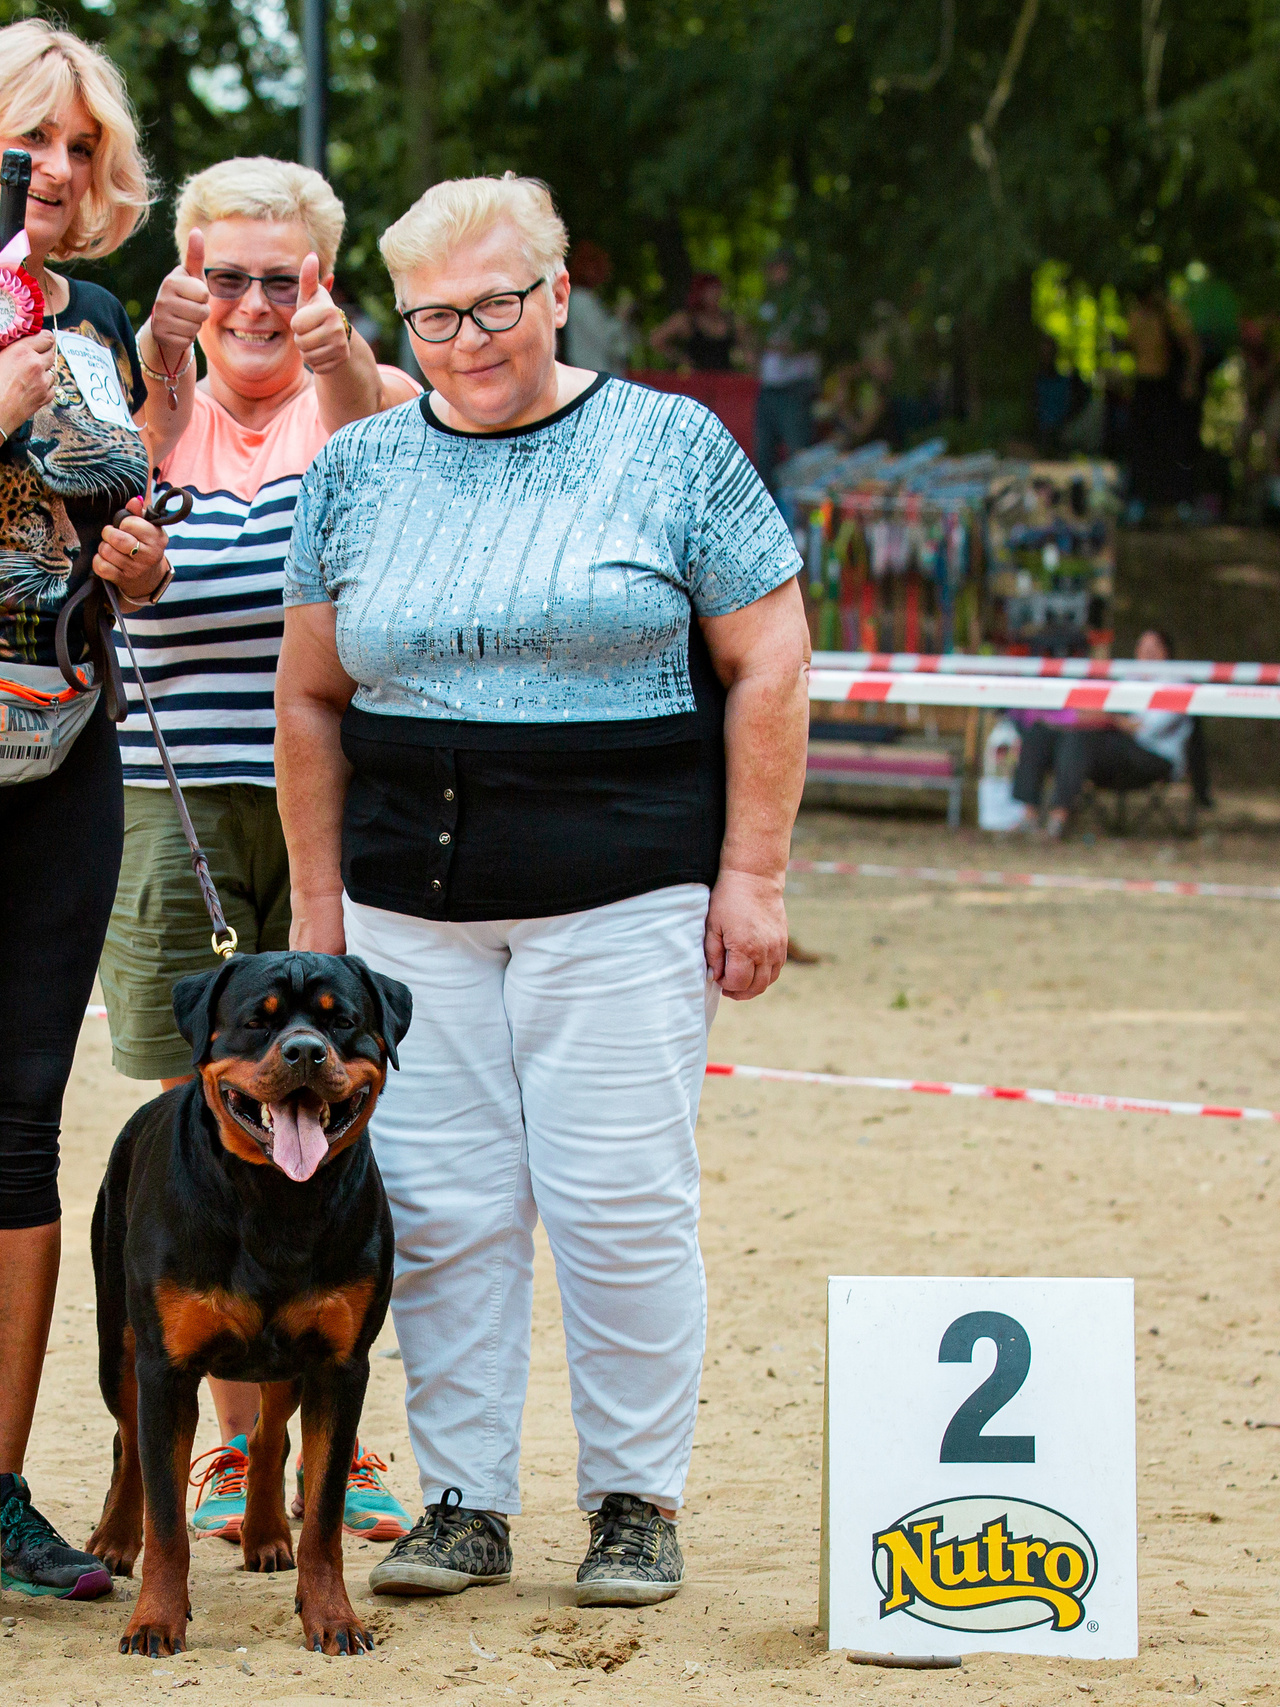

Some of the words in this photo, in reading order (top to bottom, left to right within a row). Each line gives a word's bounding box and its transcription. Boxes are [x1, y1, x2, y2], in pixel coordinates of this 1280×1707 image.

[90, 372, 120, 406] 20
[937, 1310, 1036, 1464] 2
[872, 1513, 1090, 1626] Nutro
